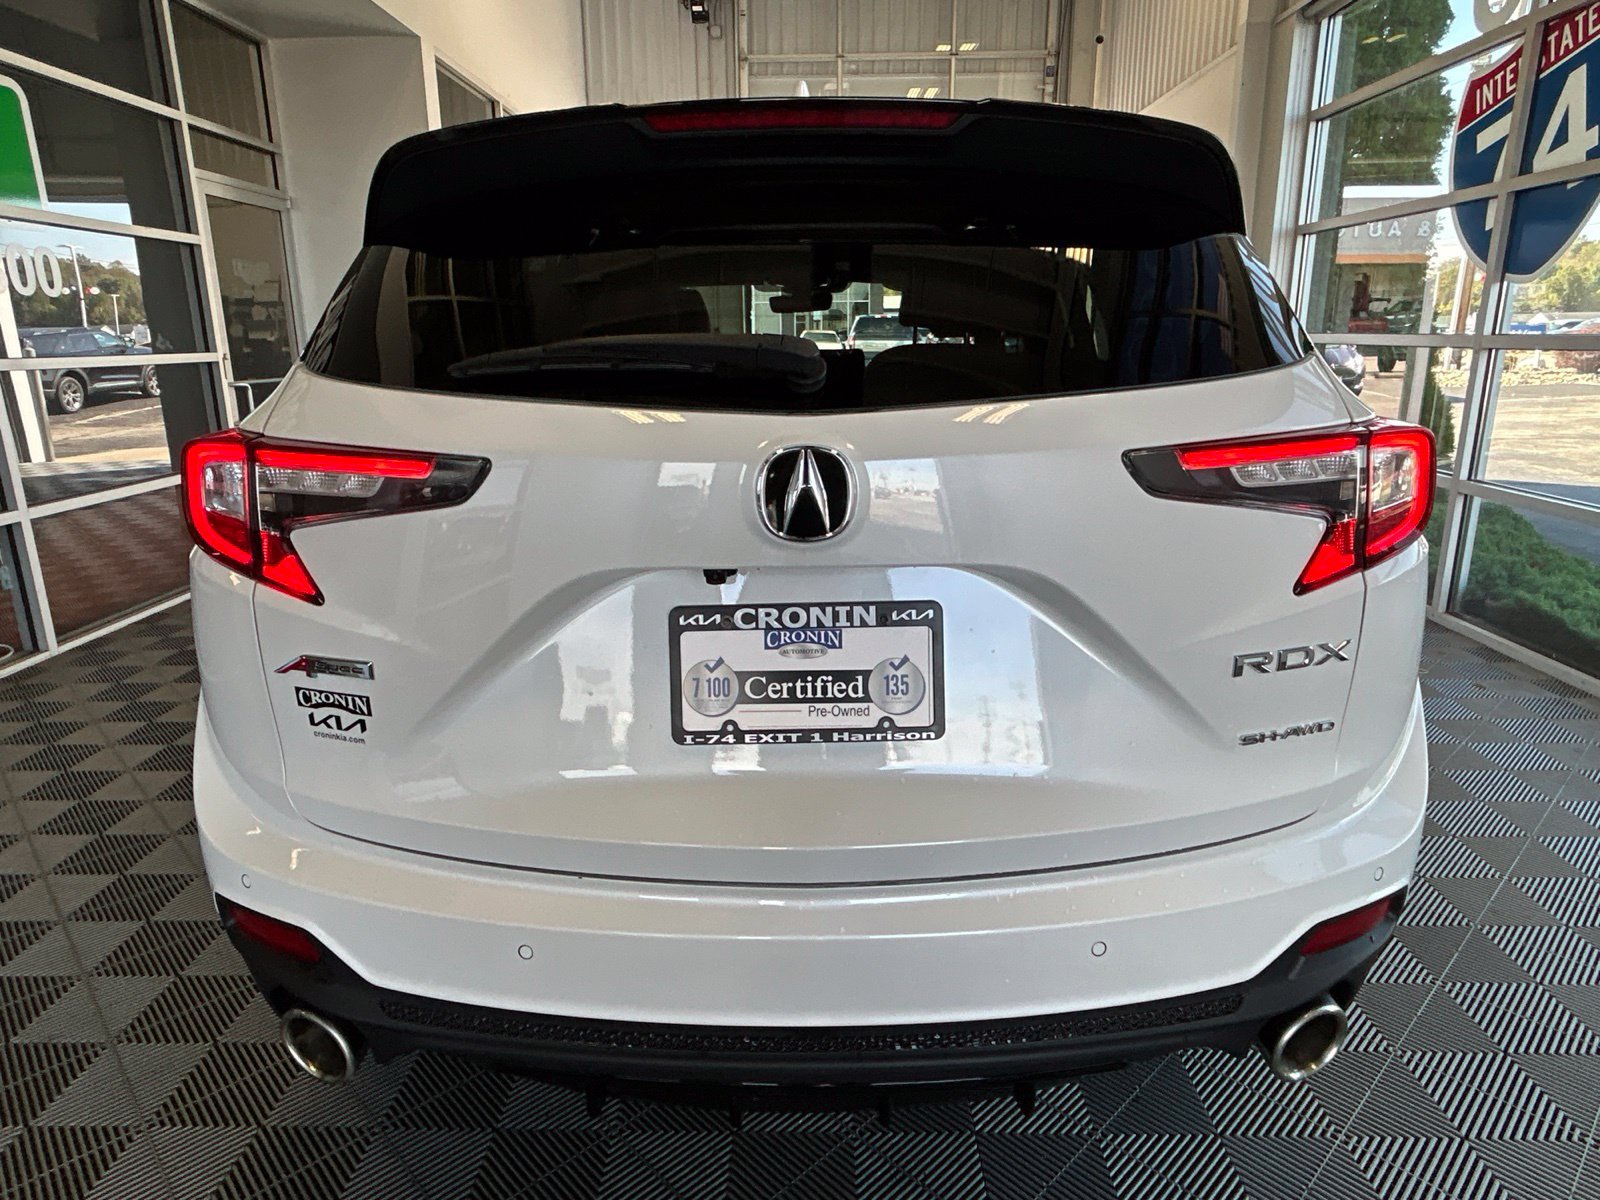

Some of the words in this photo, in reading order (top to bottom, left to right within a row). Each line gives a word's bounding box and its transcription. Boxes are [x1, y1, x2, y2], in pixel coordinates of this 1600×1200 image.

[733, 605, 877, 629] CRONIN
[766, 630, 841, 648] CRONIN
[782, 648, 826, 656] AUTOMOTIVE
[1232, 638, 1352, 678] RDX
[705, 677, 731, 698] 100
[744, 675, 865, 699] Certified
[883, 674, 909, 696] 135
[298, 689, 368, 716] CRONIN
[808, 704, 870, 718] Pre-Owned
[313, 730, 366, 744] croninkia.com
[683, 734, 736, 745] I-74
[744, 733, 802, 743] EXIT
[809, 731, 823, 742] 1
[832, 730, 936, 742] Harrison
